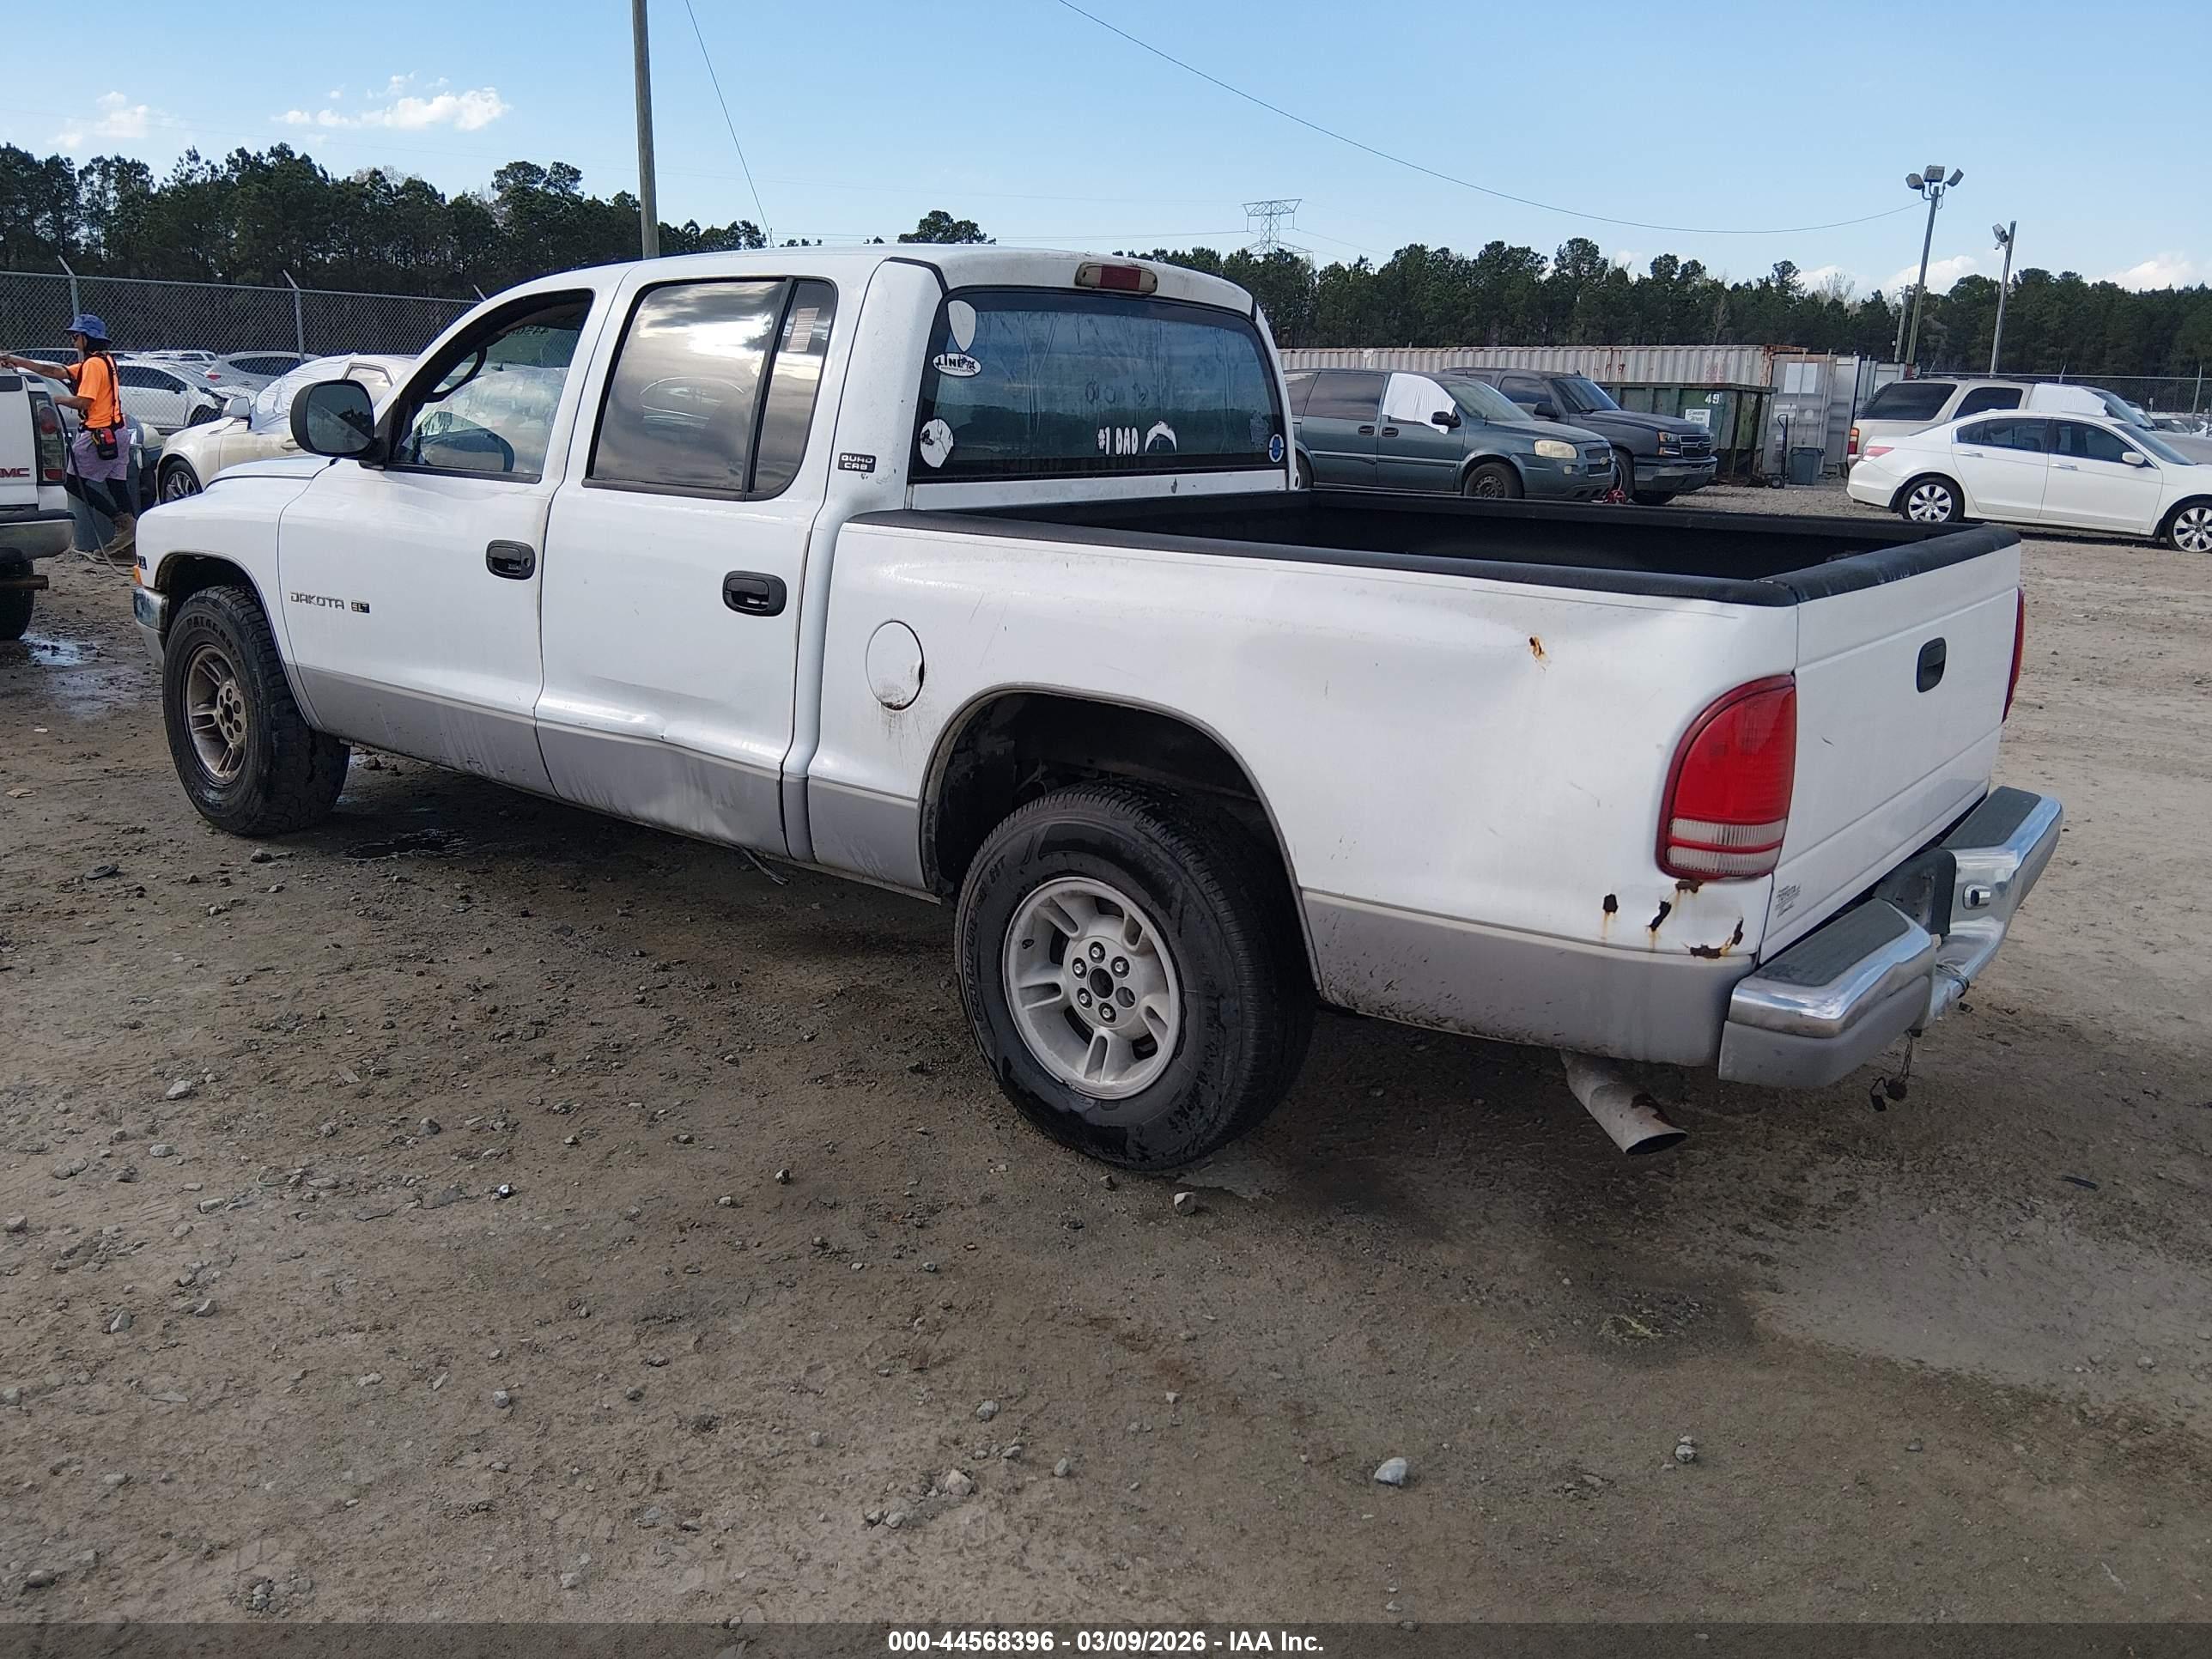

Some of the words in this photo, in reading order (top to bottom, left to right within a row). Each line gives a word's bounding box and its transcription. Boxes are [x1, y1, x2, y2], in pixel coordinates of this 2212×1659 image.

[1705, 393, 1720, 404] 49
[1097, 426, 1110, 455] #1
[1116, 426, 1138, 455] DAD
[842, 455, 873, 464] QUAD
[0, 468, 30, 478] MC
[290, 591, 345, 611] DAKOTA
[350, 602, 370, 613] SLT
